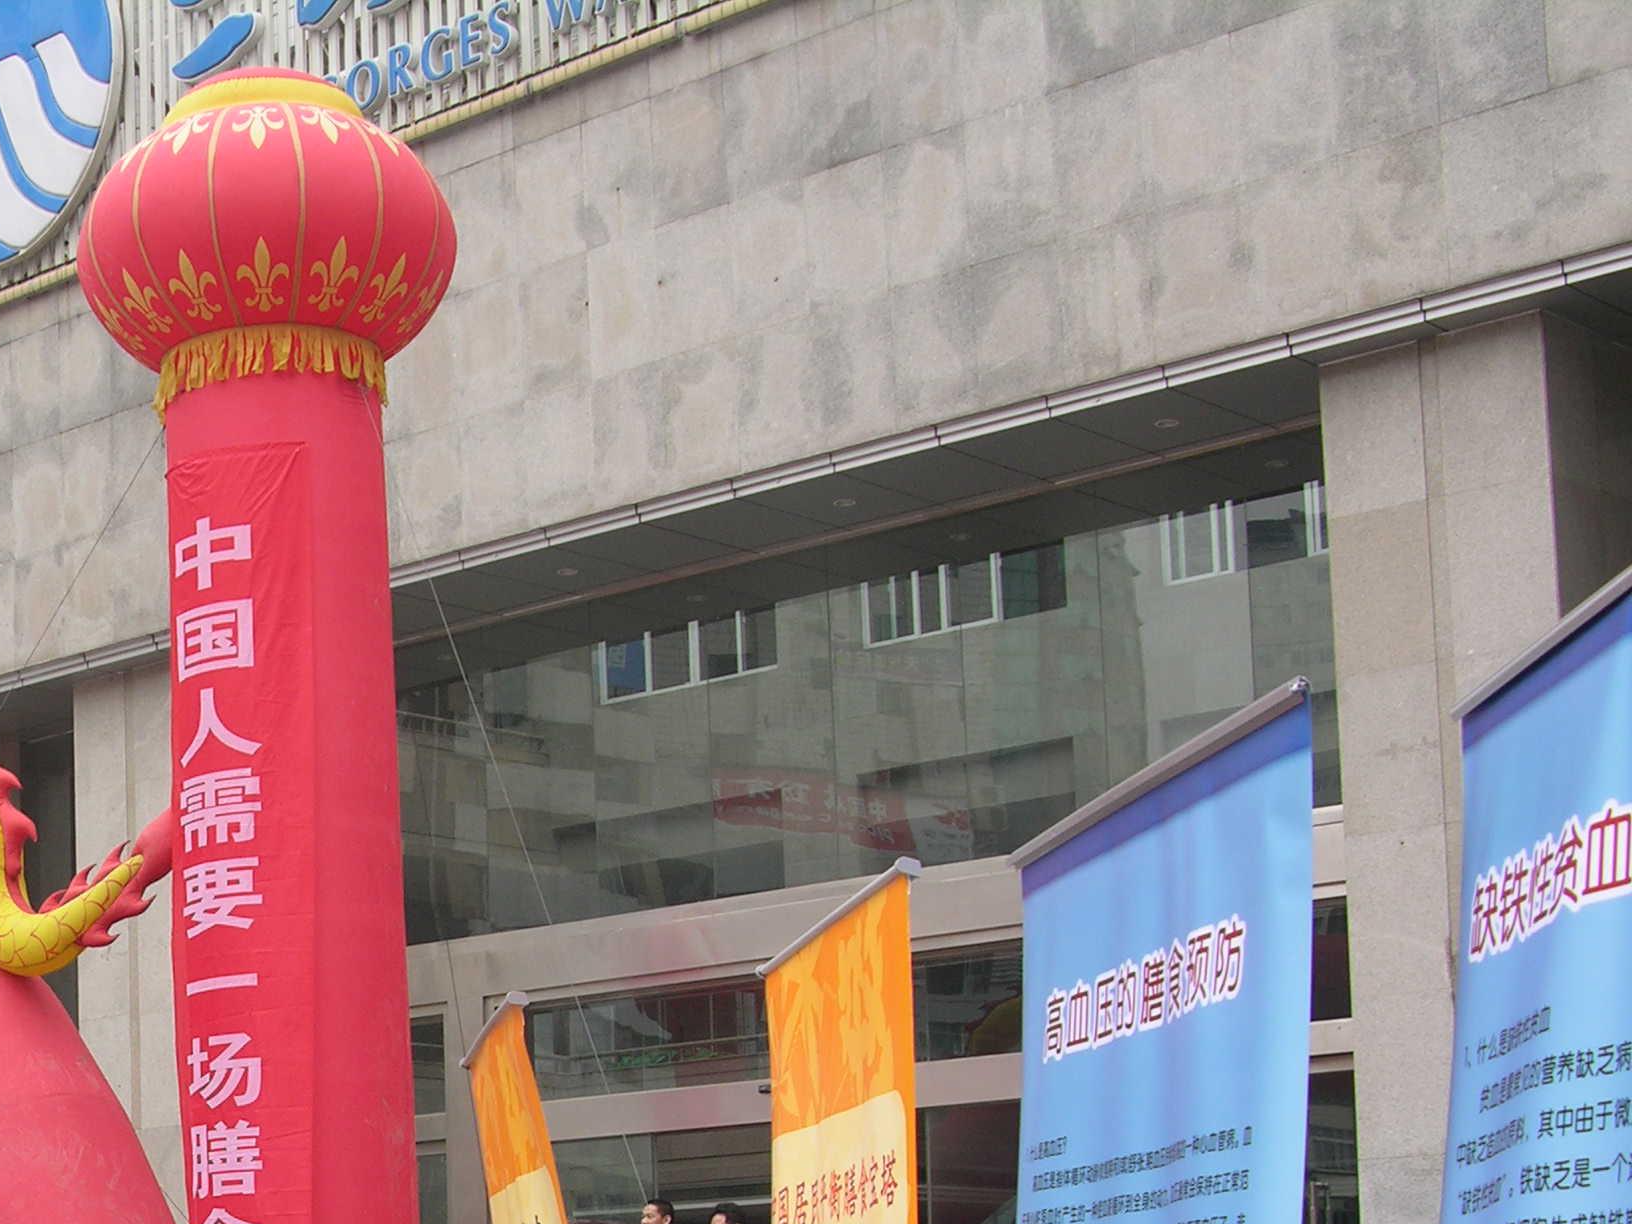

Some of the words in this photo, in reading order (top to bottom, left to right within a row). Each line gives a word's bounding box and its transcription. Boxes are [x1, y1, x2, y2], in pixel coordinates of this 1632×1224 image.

[323, 0, 511, 110] ORGES
[1470, 805, 1631, 955] 缺铁性贫血
[1046, 920, 1244, 1054] 高血压的膳食预防
